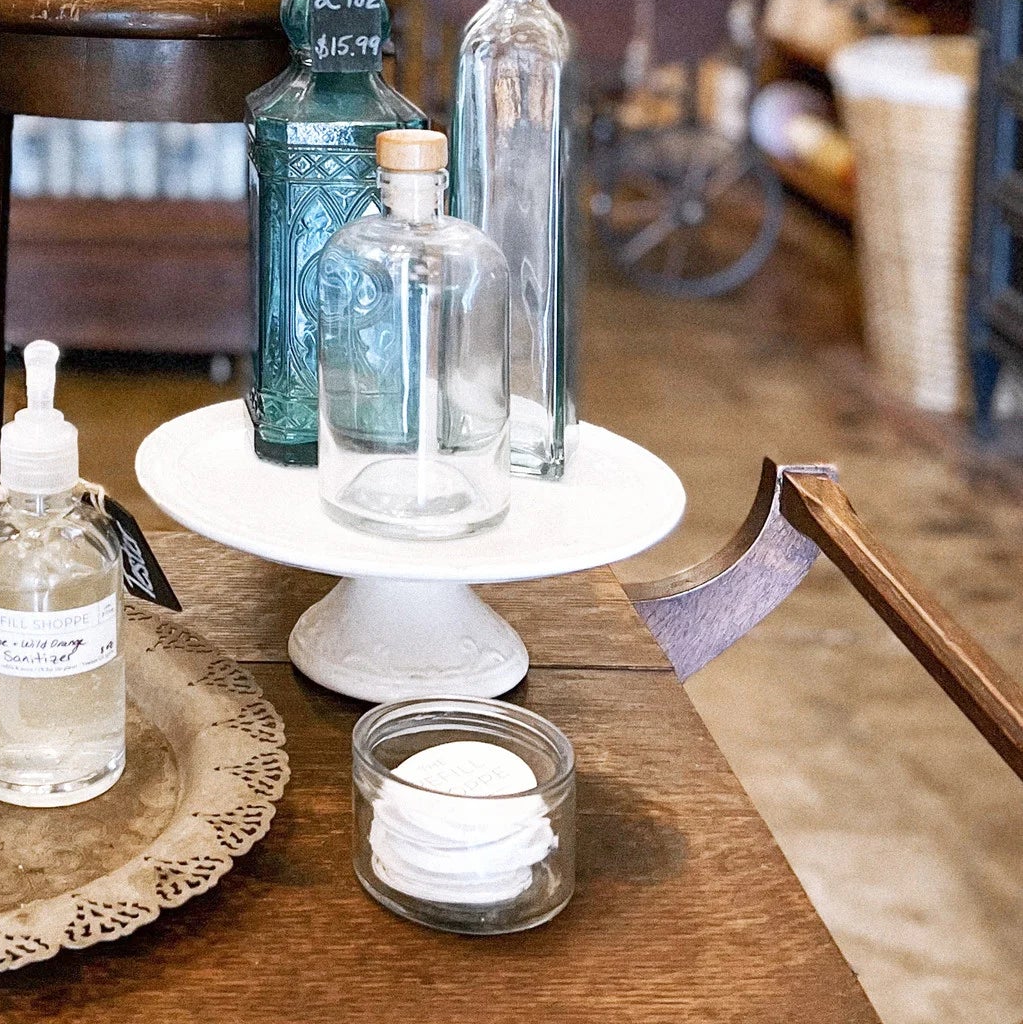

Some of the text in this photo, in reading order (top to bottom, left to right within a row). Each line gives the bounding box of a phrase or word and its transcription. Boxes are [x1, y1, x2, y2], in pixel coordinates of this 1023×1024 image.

[314, 33, 381, 60] $15.99
[33, 613, 90, 630] SHOPPE
[20, 639, 49, 650] Wild
[1, 648, 72, 666] Sanitizer
